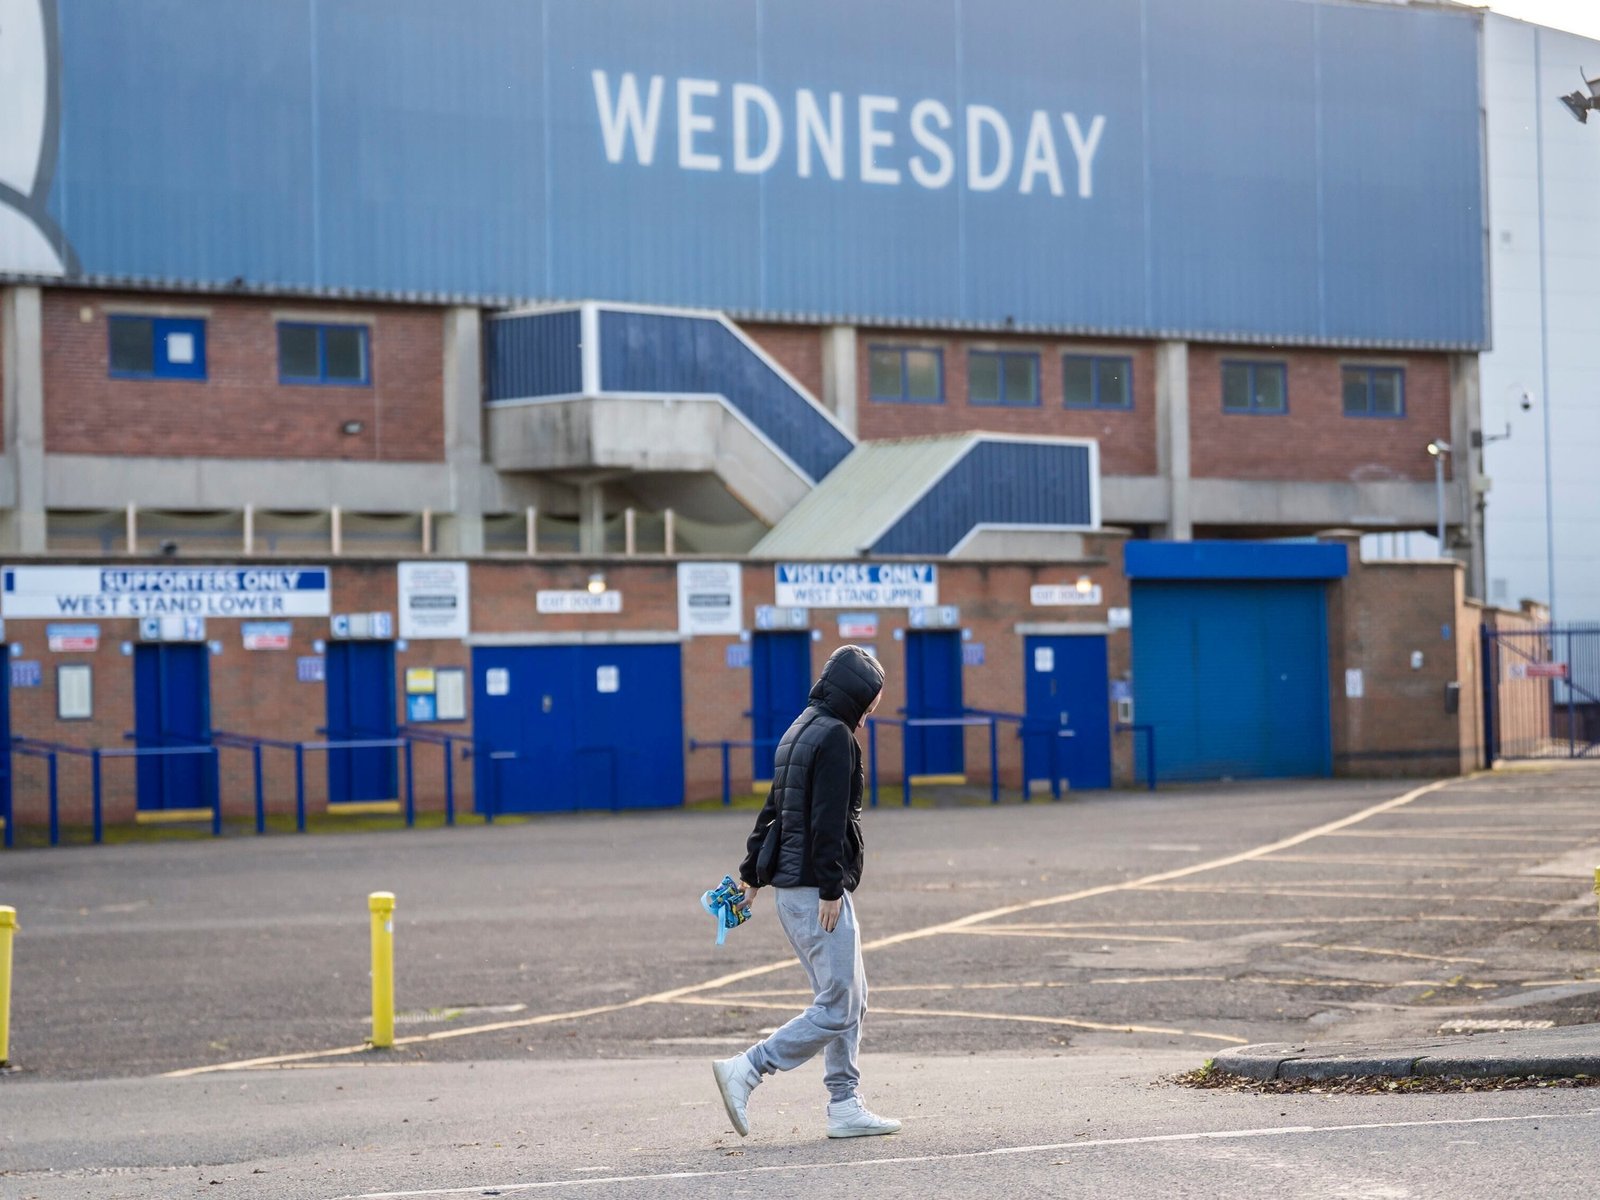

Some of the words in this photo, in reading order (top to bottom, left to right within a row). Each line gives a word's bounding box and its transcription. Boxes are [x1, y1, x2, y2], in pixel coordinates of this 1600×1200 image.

[591, 69, 1106, 199] WEDNESDAY
[103, 572, 238, 591] SUPPORTERS
[243, 571, 299, 591] ONLY
[782, 565, 869, 583] VISITORS
[878, 565, 929, 583] ONLY
[794, 587, 832, 601] WEST
[837, 587, 879, 601] STAND
[882, 587, 922, 601] UPPER
[57, 596, 118, 612] WEST
[129, 596, 201, 613] STAND
[207, 596, 284, 613] LOWER
